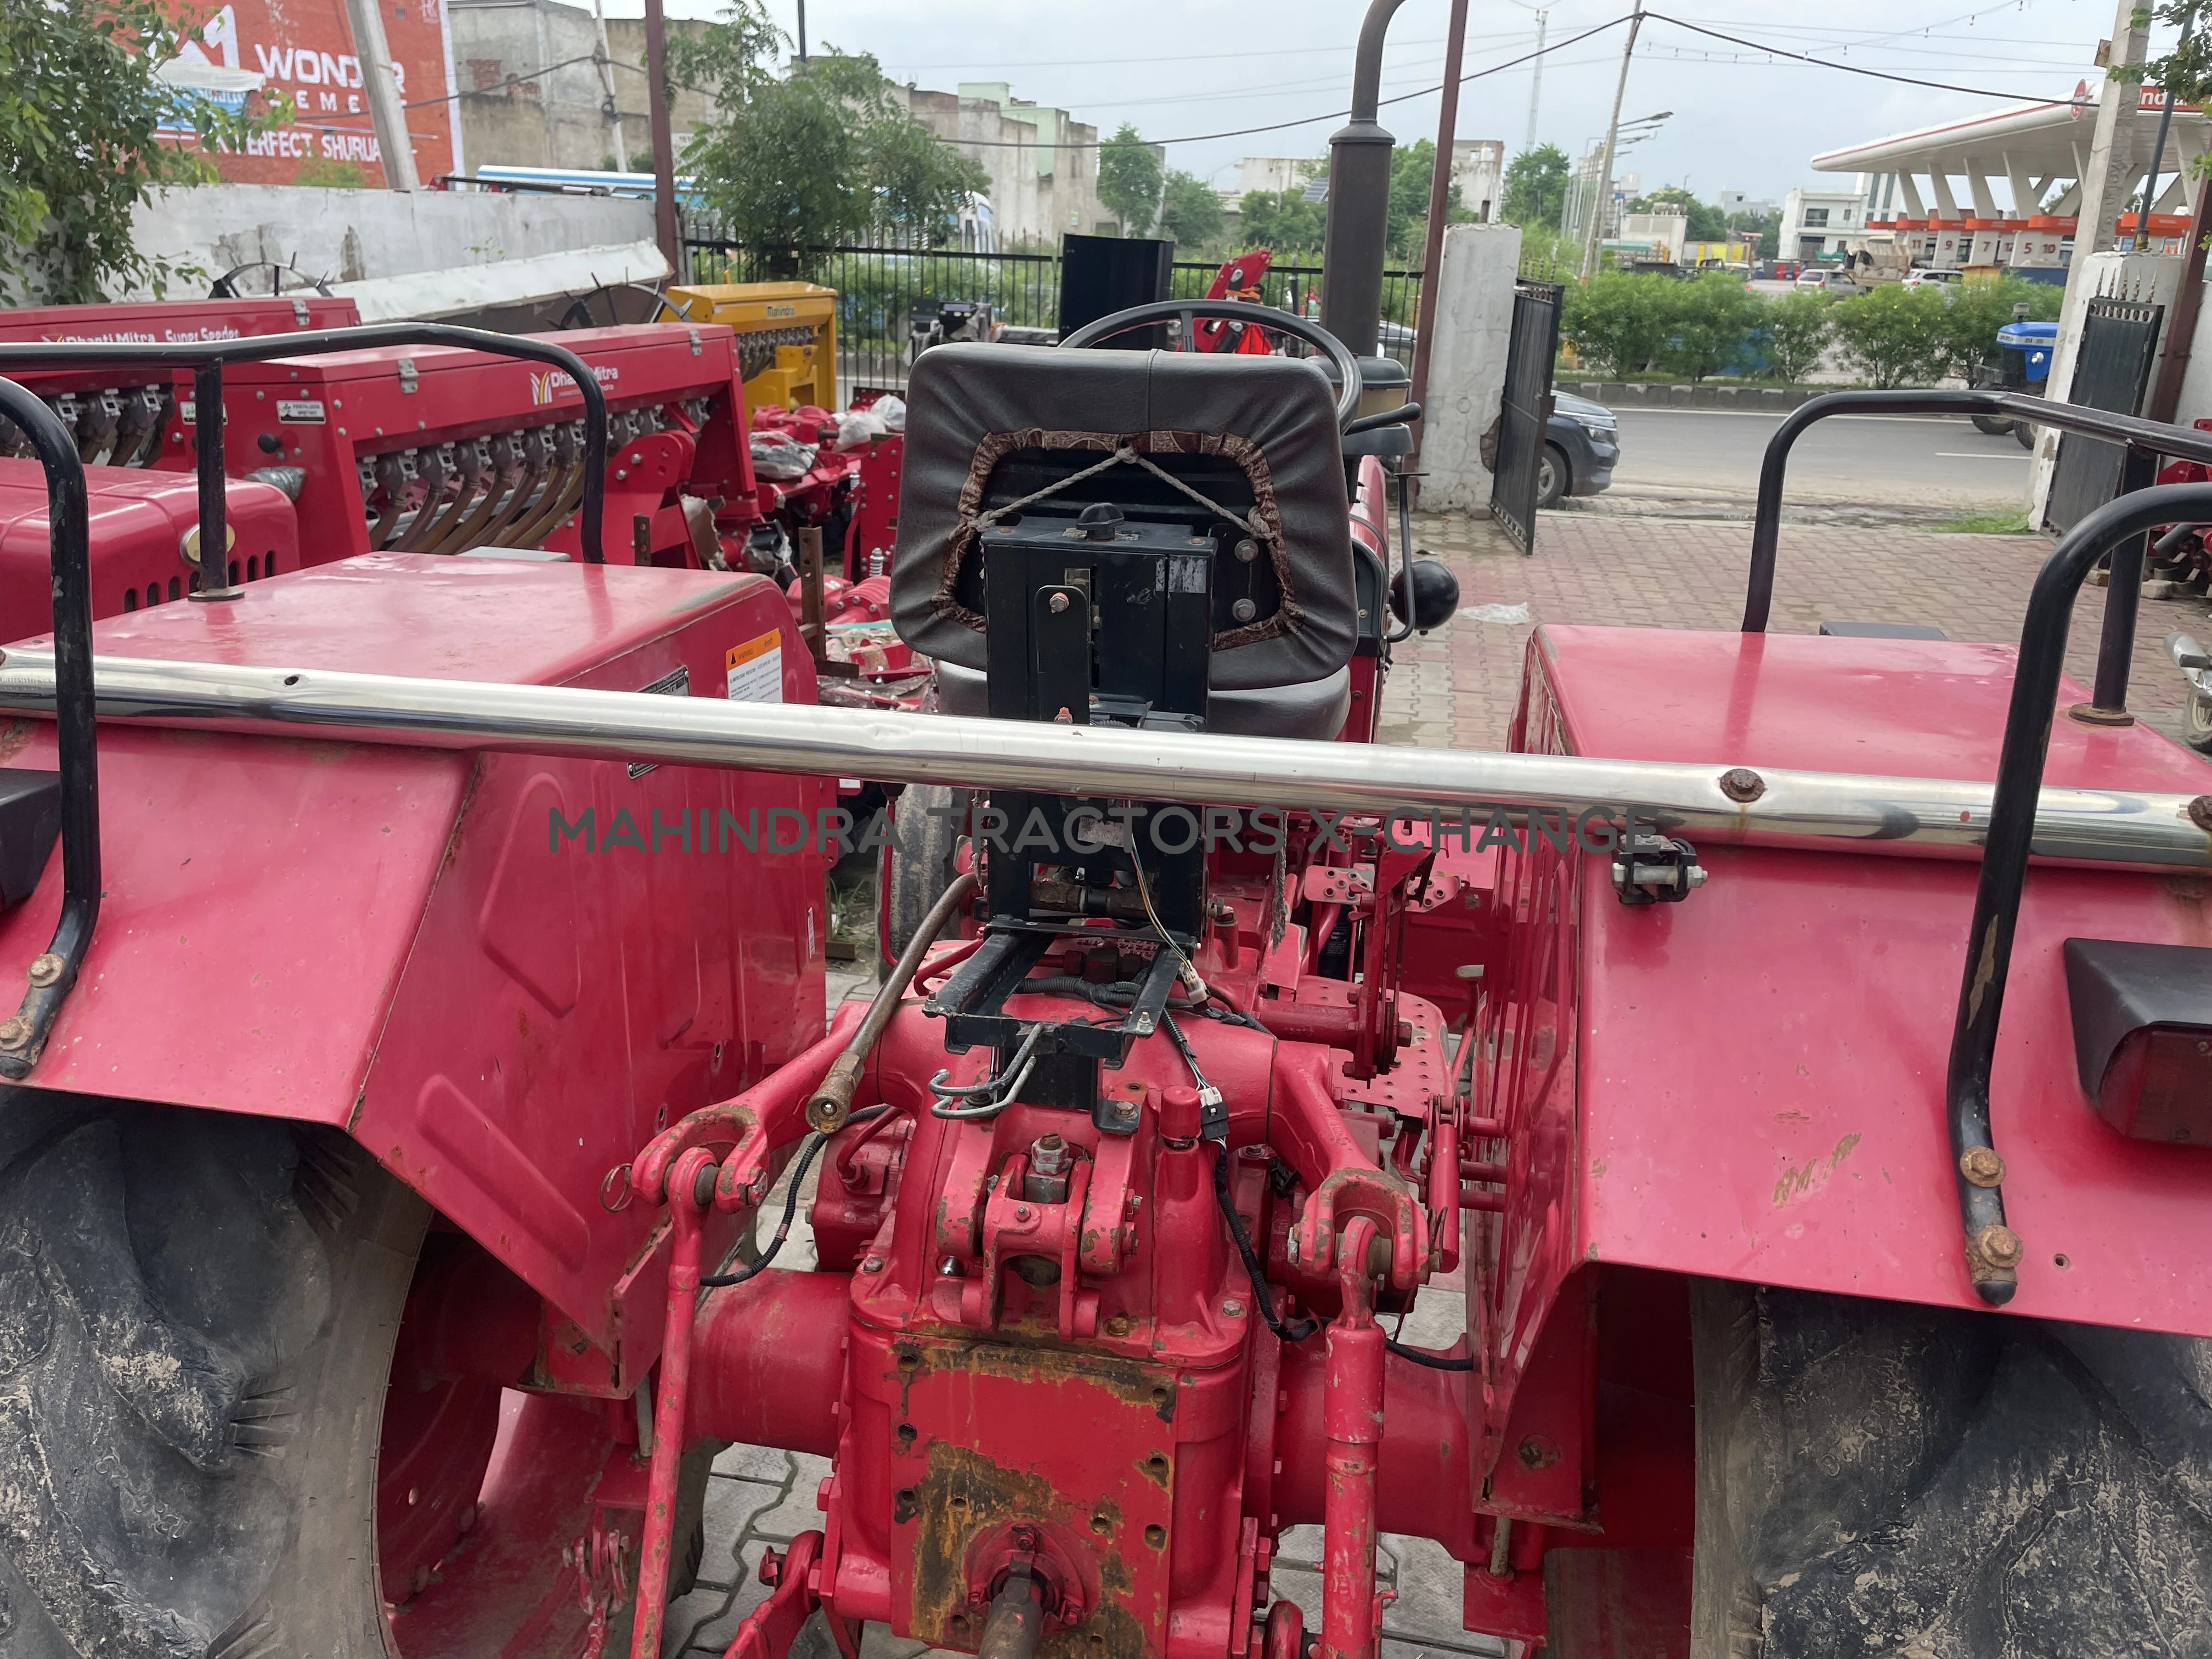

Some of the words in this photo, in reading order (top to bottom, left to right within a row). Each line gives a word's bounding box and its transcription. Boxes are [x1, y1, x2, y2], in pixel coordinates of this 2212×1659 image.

[1945, 240, 1953, 250] 9
[1983, 241, 1990, 252] 7
[2024, 242, 2032, 254] 5
[2042, 244, 2056, 253] 10
